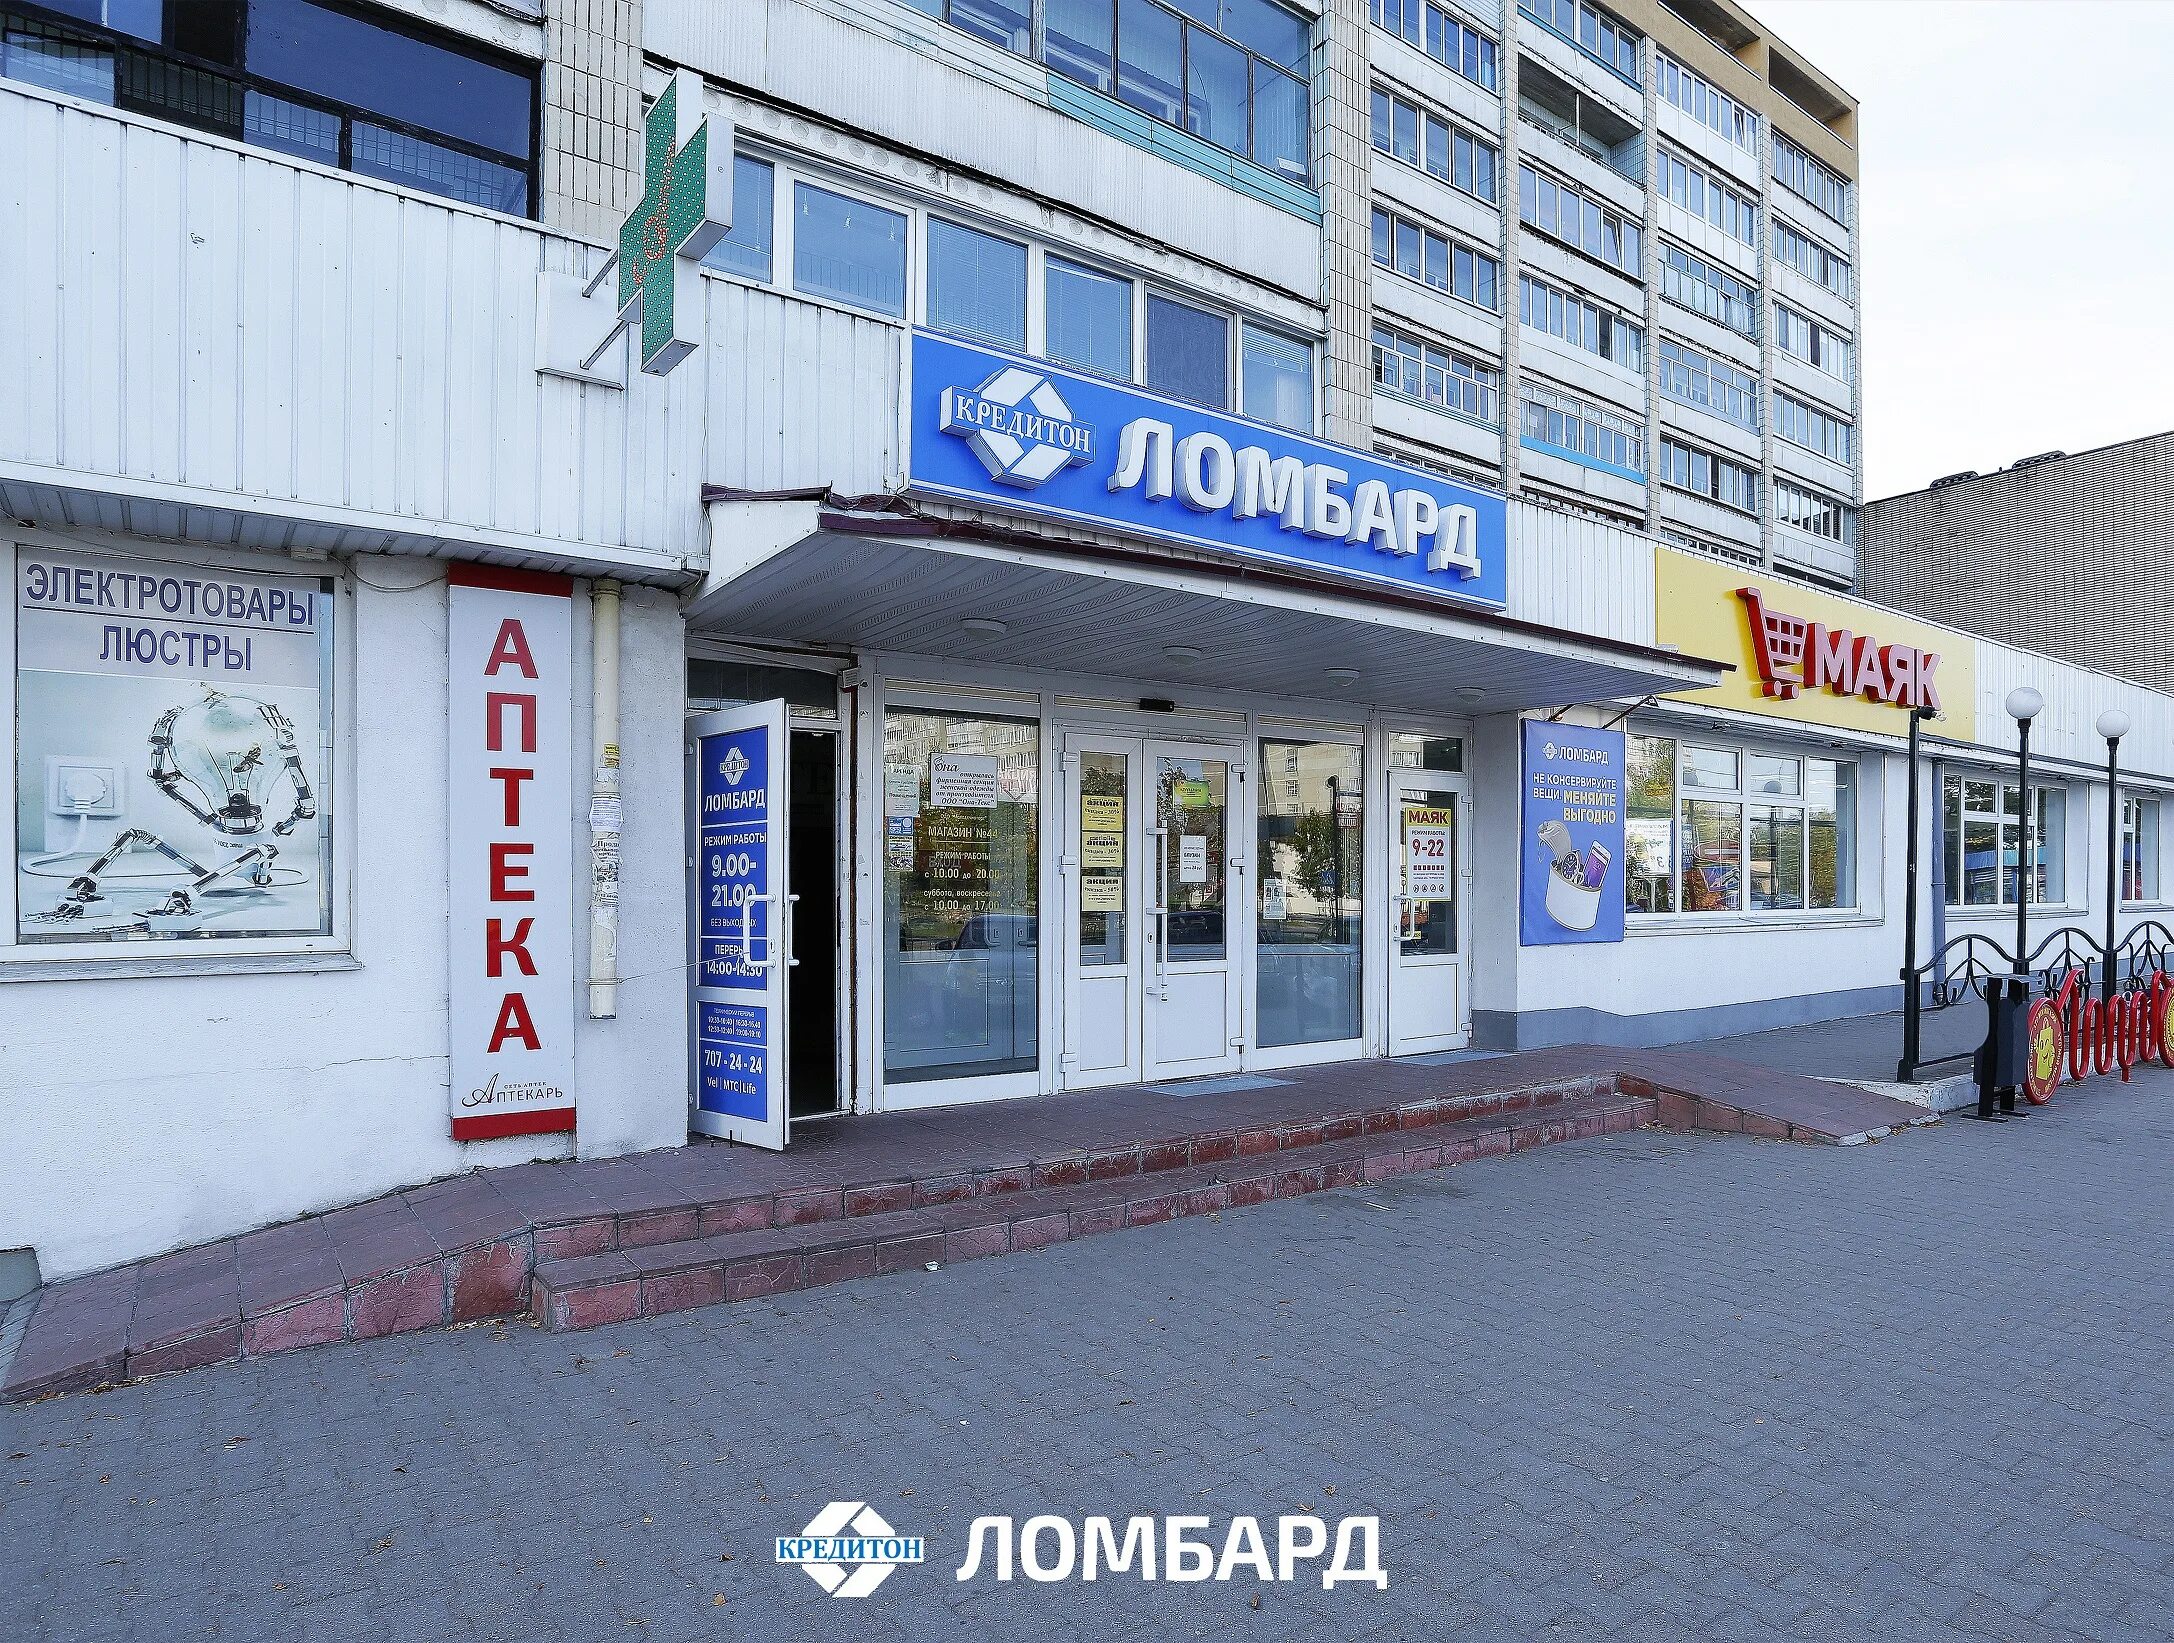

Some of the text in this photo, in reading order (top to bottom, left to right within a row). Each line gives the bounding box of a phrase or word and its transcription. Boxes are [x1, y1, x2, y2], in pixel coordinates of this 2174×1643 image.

[956, 394, 1091, 454] КРЕДИТОН
[1107, 417, 1482, 581] ЛОМБАРД
[26, 563, 314, 626] ЭЛЕКТРОТОВАРЫ
[100, 625, 251, 671] ЛЮСТРЫ
[1804, 622, 1942, 711] МАЯК
[1559, 746, 1609, 766] ЛОМБАРД
[1533, 772, 1617, 790] НЕ КОНСЕРВИРУЙТЕ
[704, 788, 766, 812] ЛОМБАРД
[941, 797, 958, 805] ООО
[1533, 787, 1617, 807] ВЕЩИ. МЕНЯЙТЕ
[1408, 810, 1448, 824] МАЯК
[1563, 807, 1616, 825] ВЫГОДНО
[484, 618, 542, 1054] АПТЕКА
[704, 831, 767, 847] РЕЖИМ РАБОТЫ
[928, 826, 973, 838] МАГАЗИН
[935, 851, 991, 860] РЕЖИМ РАБОТЫ
[1412, 838, 1445, 857] 9-22
[711, 852, 757, 877] 9.00-
[933, 867, 959, 879] 10.00
[975, 868, 1000, 879] 20.00
[711, 883, 757, 907] 21.00
[923, 888, 955, 898] суббота,
[933, 900, 959, 911] 10.00
[974, 900, 1000, 911] 17.00
[710, 918, 757, 928] БЕЗ ВЫХОДЫХ
[704, 1049, 722, 1068] 707
[729, 1052, 742, 1071] 24
[749, 1055, 763, 1075] 24
[707, 1076, 718, 1088] Vel
[742, 1081, 757, 1095] Life
